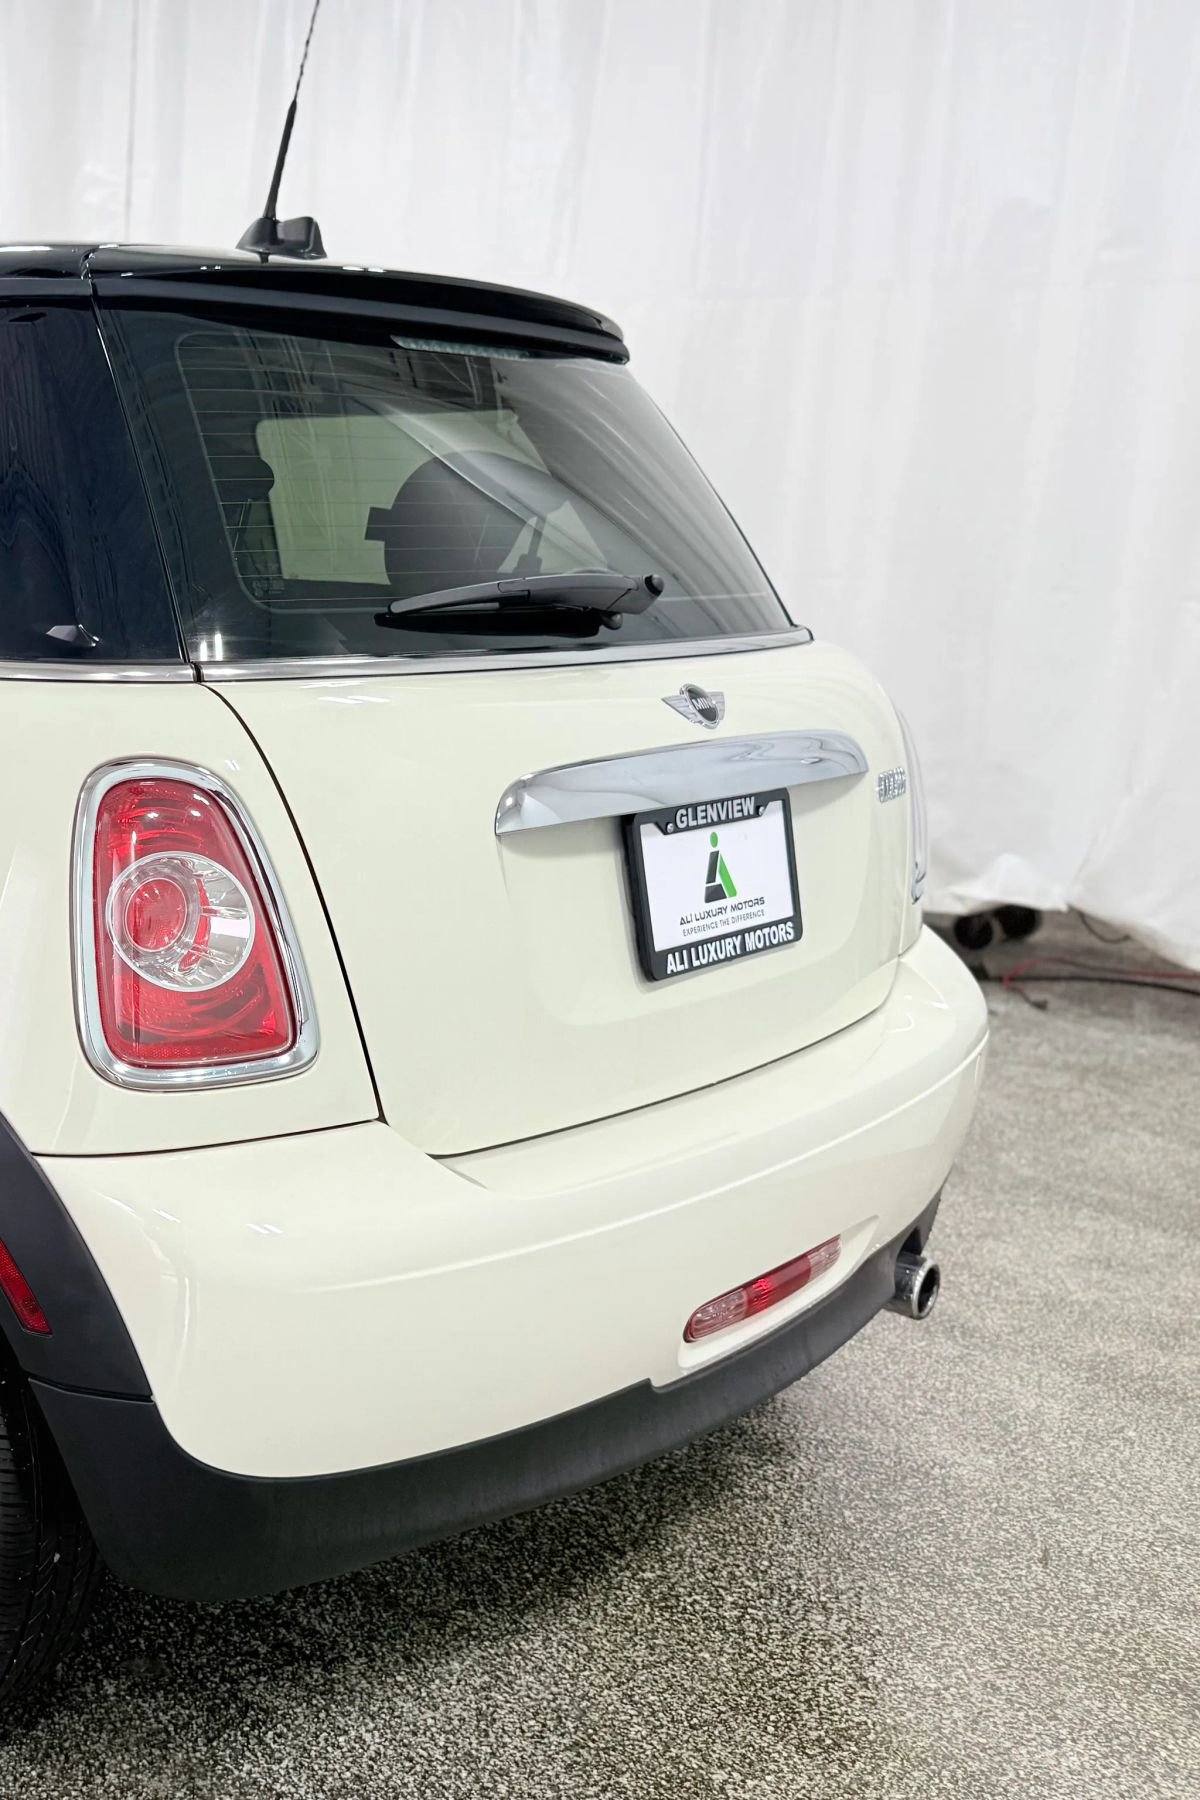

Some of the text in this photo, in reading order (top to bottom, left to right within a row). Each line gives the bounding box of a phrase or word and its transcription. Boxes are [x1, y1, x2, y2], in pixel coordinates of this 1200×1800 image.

[676, 797, 755, 829] GLENVIEW
[680, 897, 765, 925] ALI LUXURY MOTORS
[682, 908, 765, 937] EXPERIENCE THE DIFFERENCE
[666, 921, 795, 975] ALI LUXURY MOTORS
